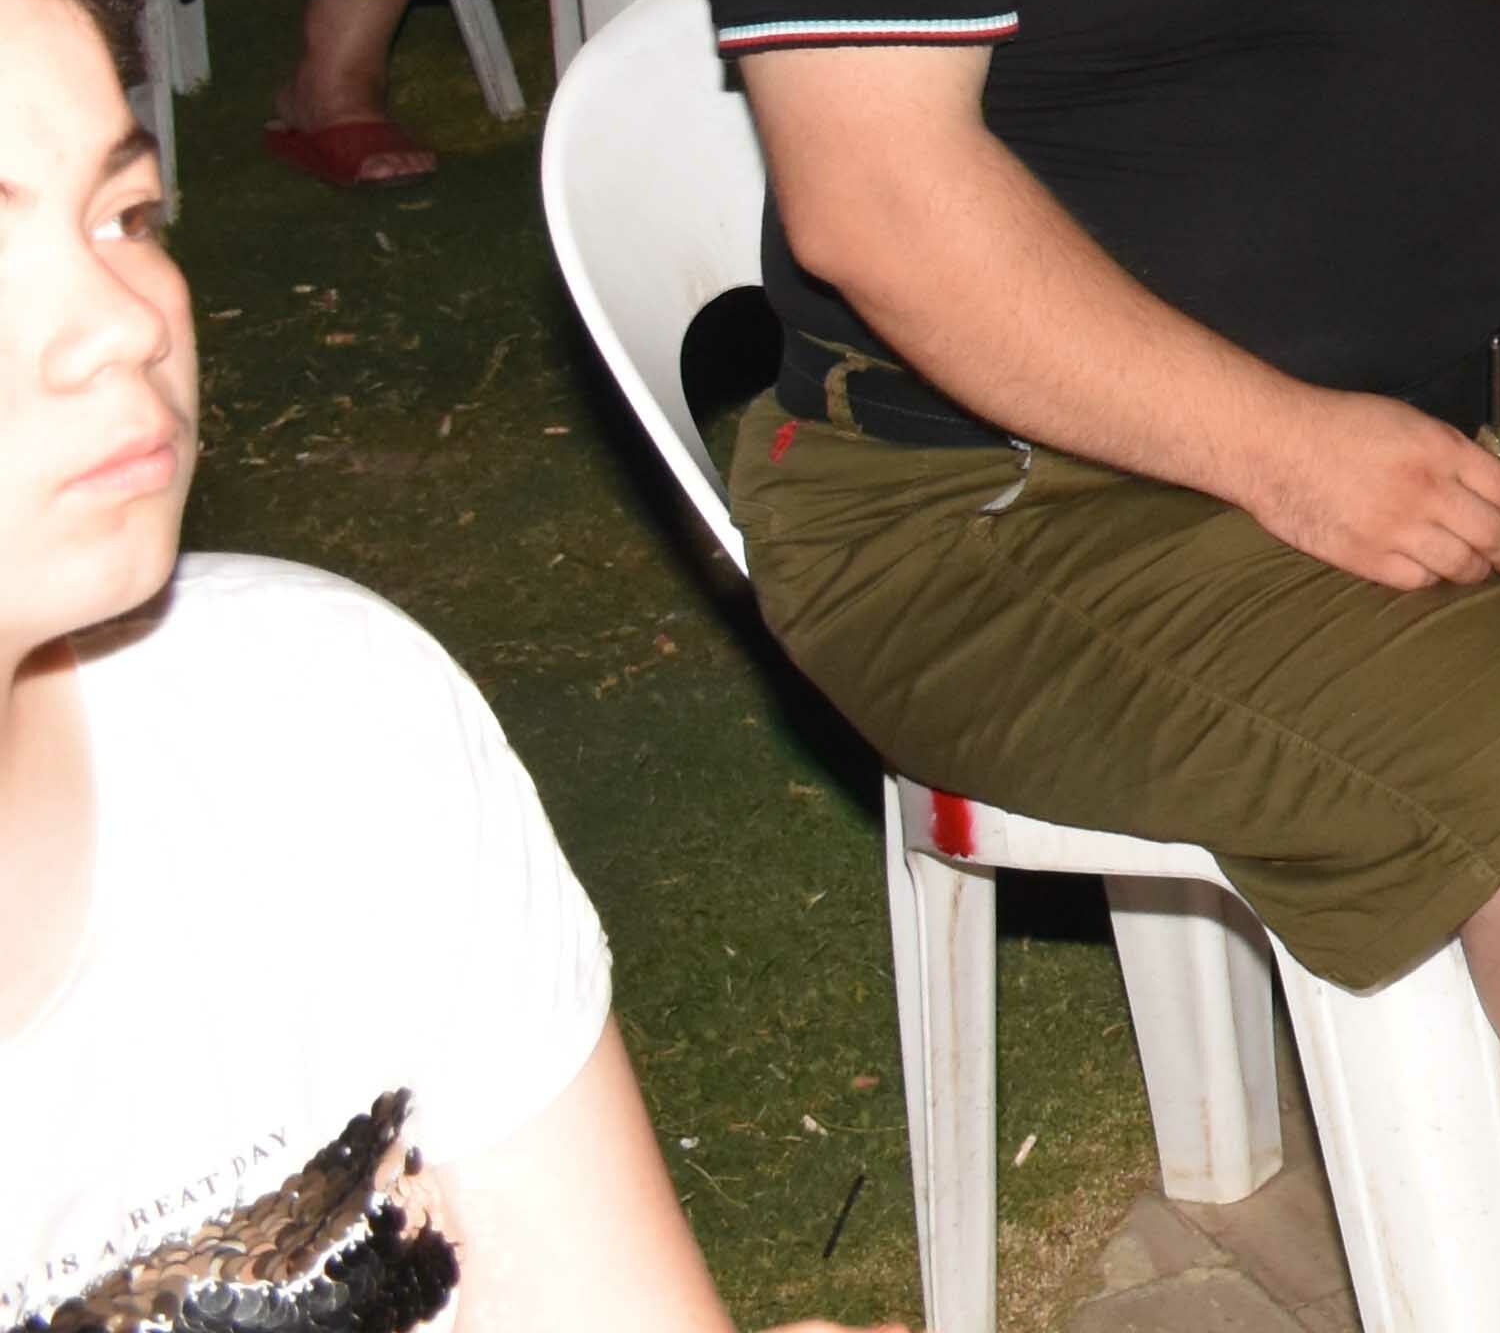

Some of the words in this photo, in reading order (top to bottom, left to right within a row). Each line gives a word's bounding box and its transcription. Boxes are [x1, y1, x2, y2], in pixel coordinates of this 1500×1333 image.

[42, 1252, 81, 1282] IS
[98, 1239, 118, 1263] A
[121, 1172, 222, 1232] REAT
[230, 1126, 291, 1179] DAY
